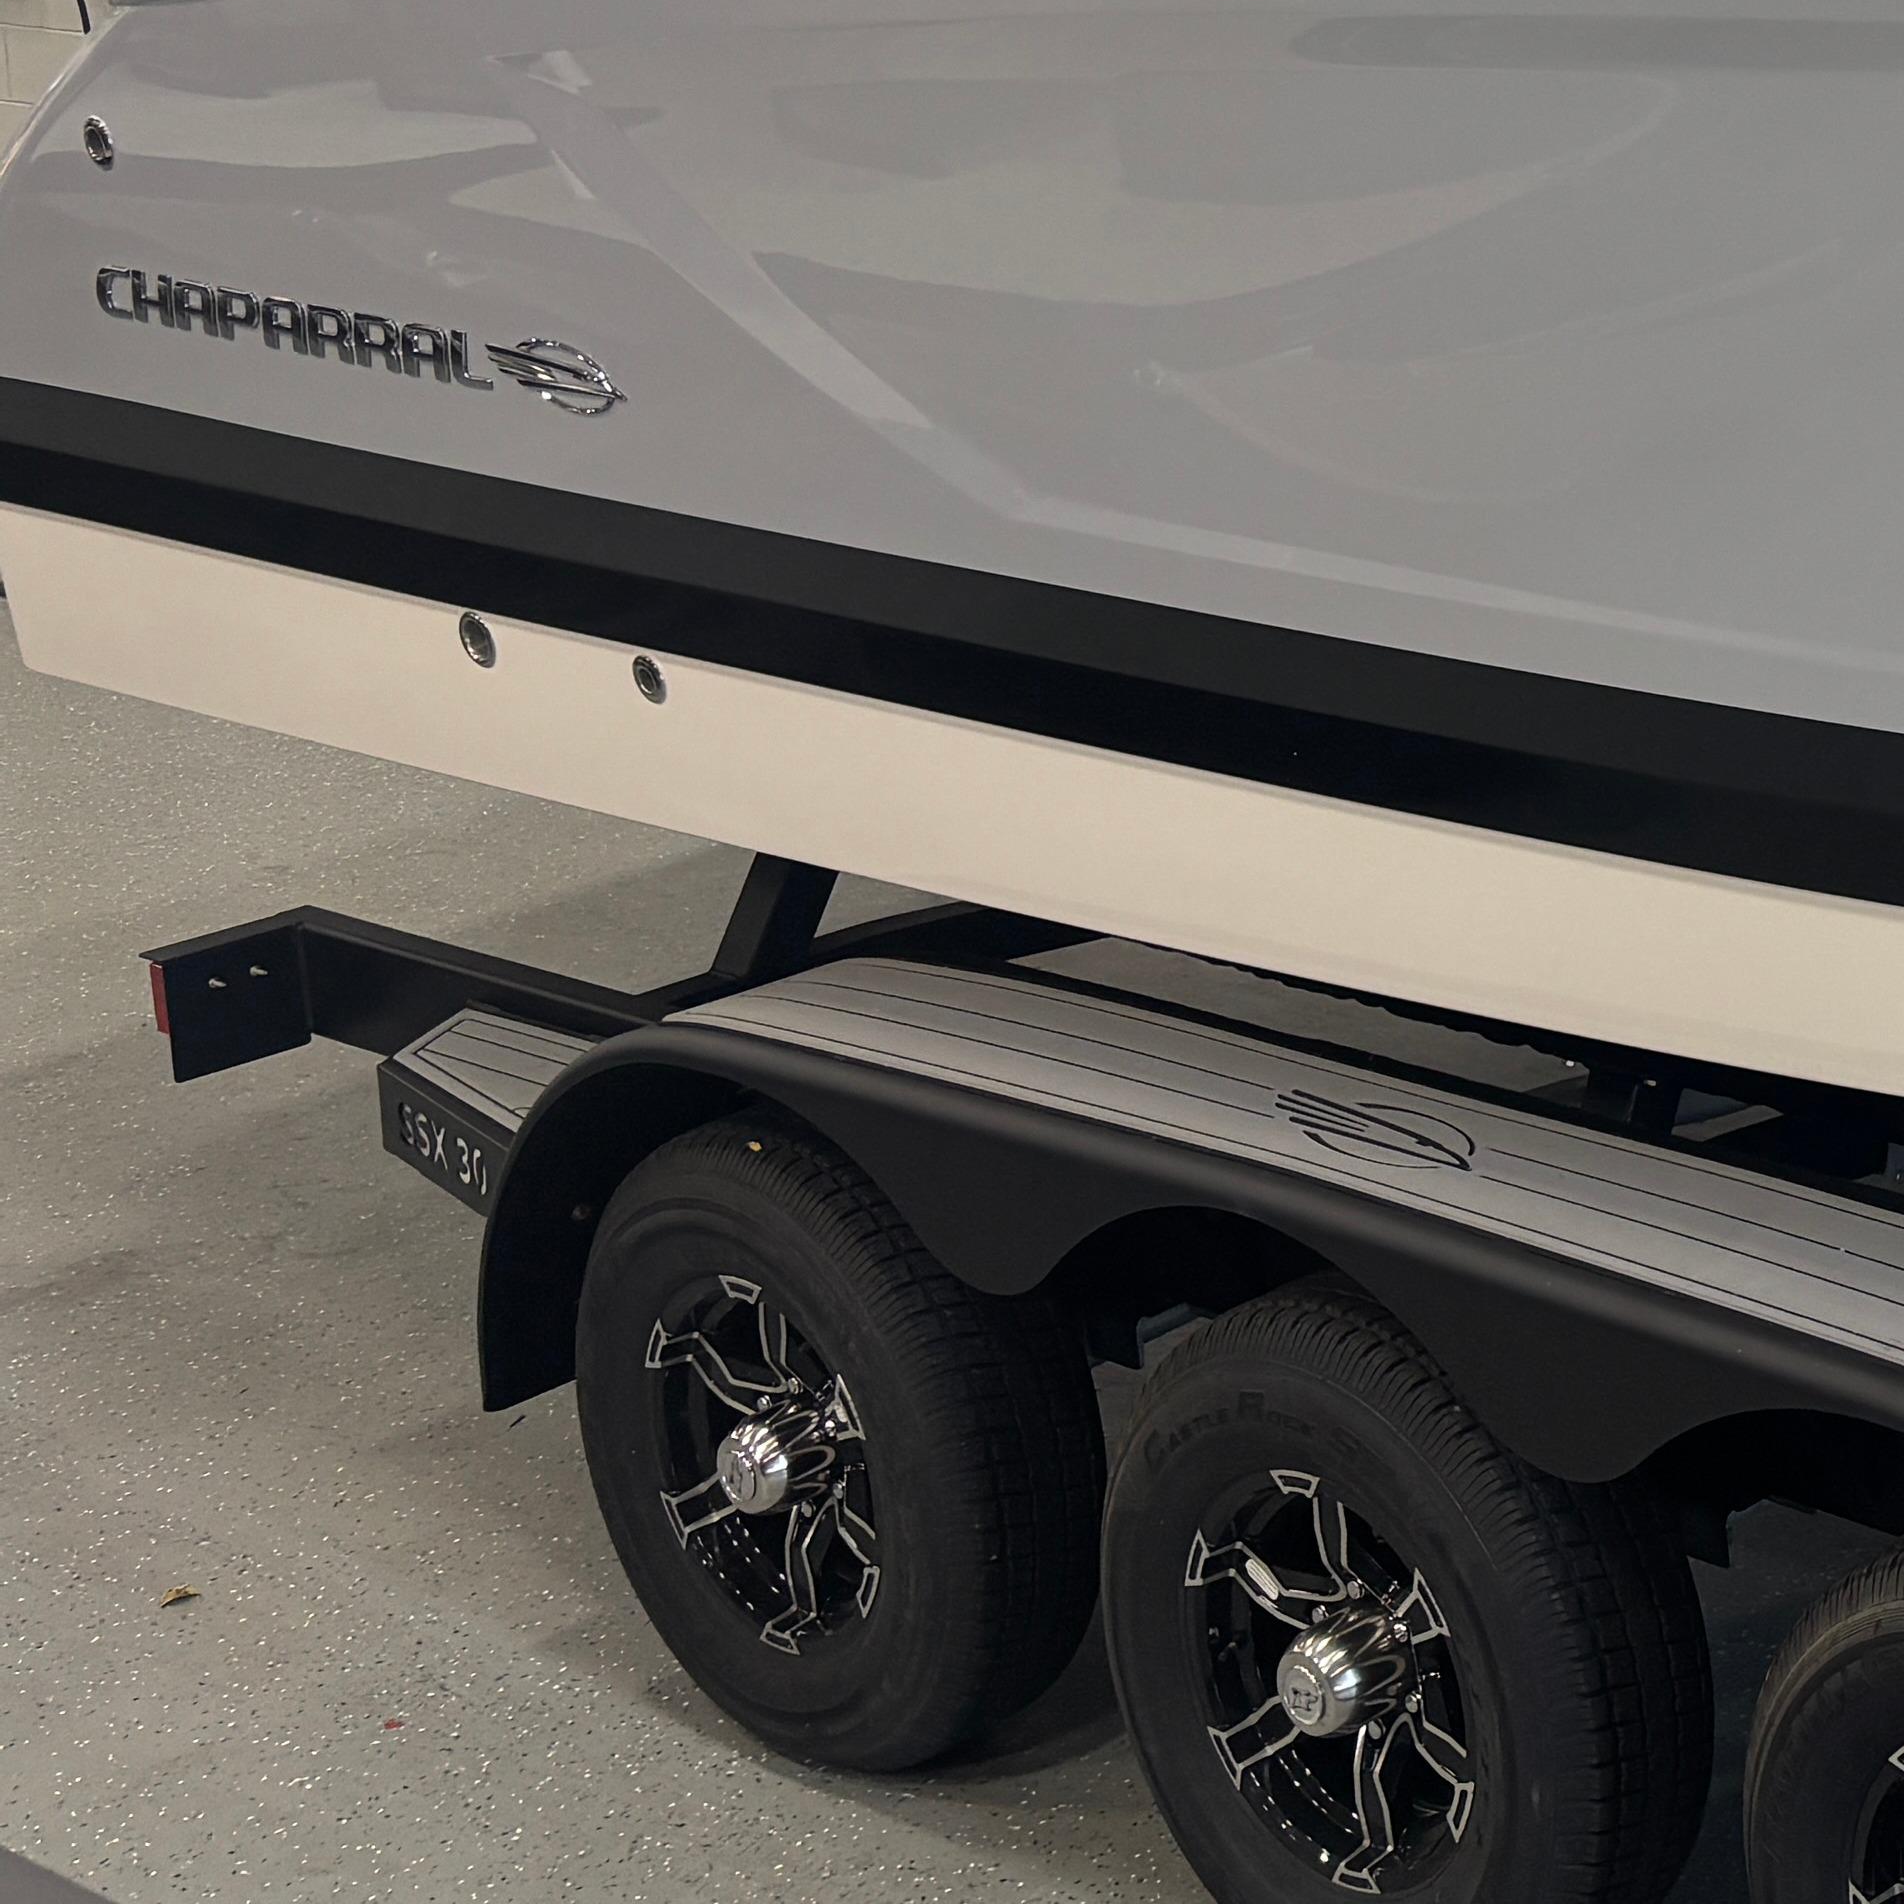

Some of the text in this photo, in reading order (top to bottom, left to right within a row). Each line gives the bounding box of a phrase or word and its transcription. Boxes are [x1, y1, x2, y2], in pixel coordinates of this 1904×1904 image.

[96, 264, 494, 390] CHAPARRAL
[399, 1103, 487, 1195] SSX 30
